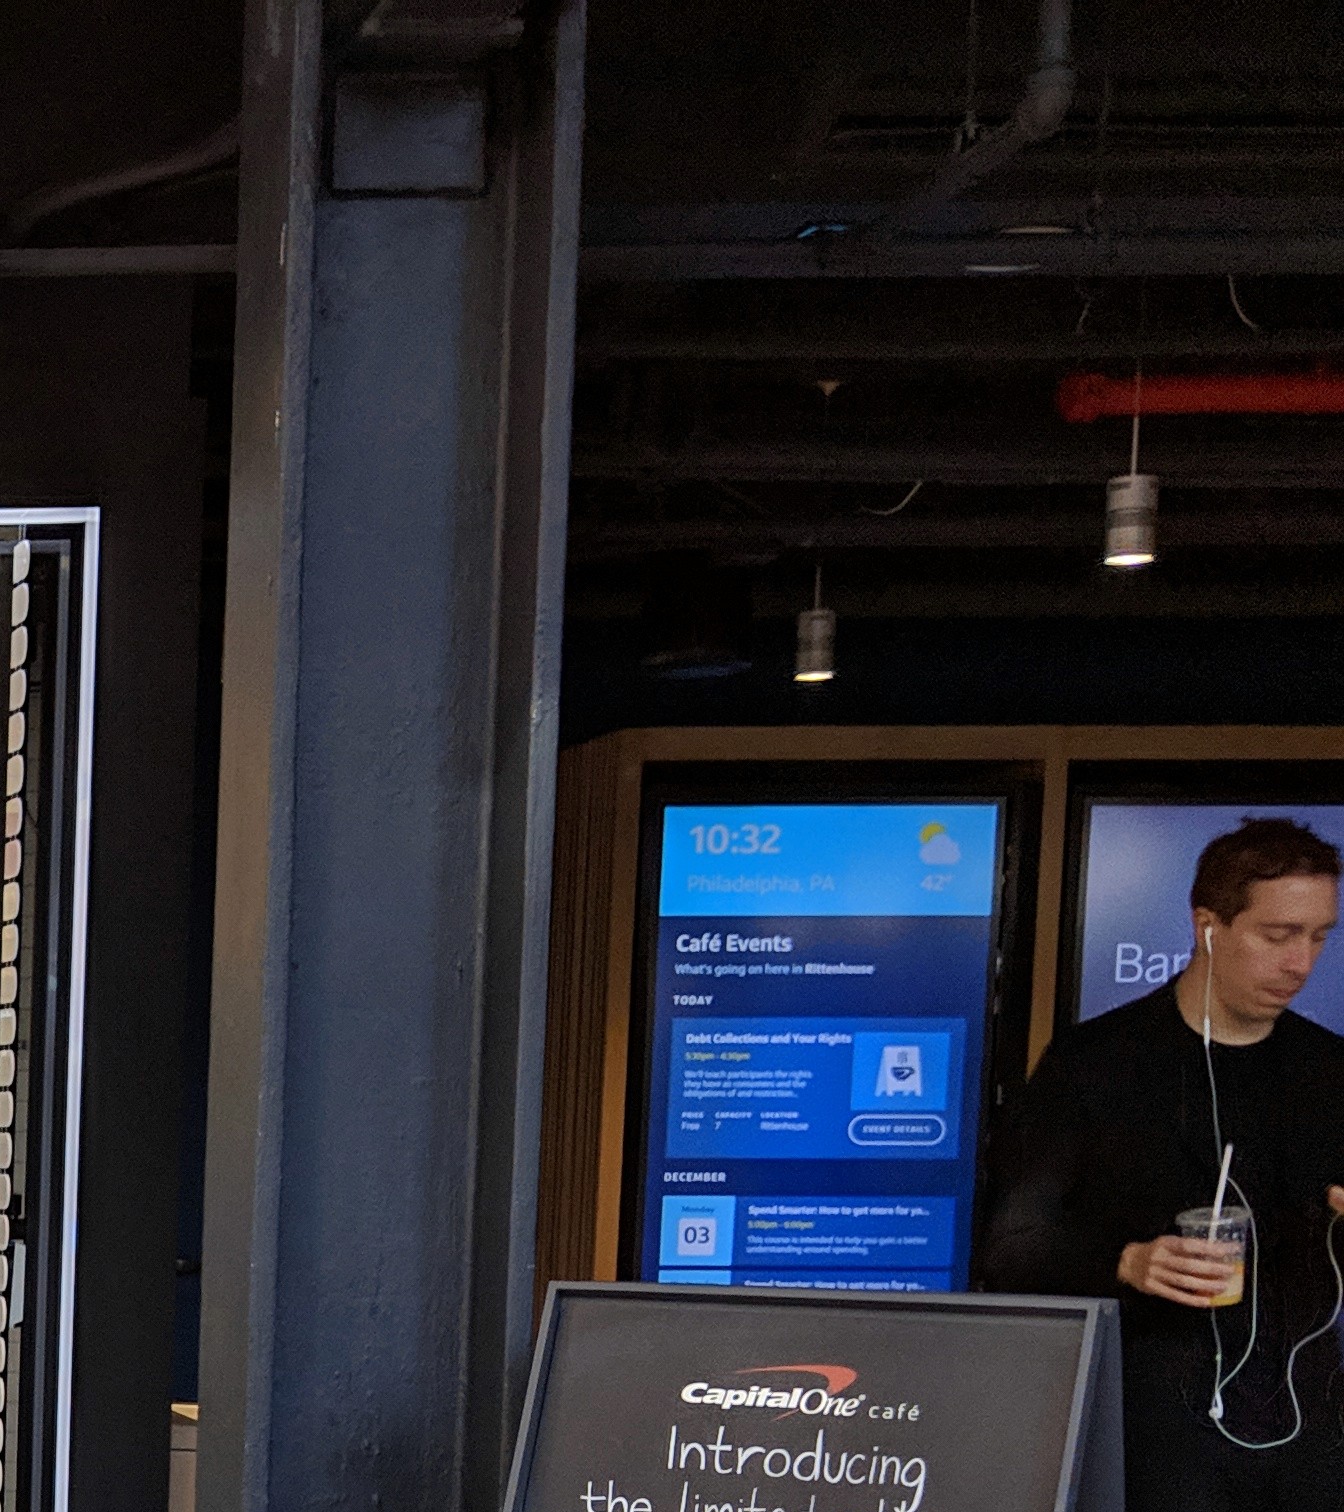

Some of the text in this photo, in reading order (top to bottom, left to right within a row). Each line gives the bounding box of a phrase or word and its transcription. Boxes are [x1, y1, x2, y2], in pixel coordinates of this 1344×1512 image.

[690, 824, 782, 855] 10:32
[687, 875, 836, 894] Philadelphia, PA
[676, 932, 794, 953] Café Events
[674, 964, 712, 975] What's
[714, 964, 746, 977] going
[748, 965, 763, 975] on
[764, 963, 790, 975] here
[792, 964, 803, 975] in
[673, 995, 713, 1006] TODAY
[685, 1033, 852, 1046] Debt Collections and Your Rights
[663, 1172, 726, 1183] DECEMBER
[683, 1226, 711, 1244] 03
[868, 1402, 921, 1422] café
